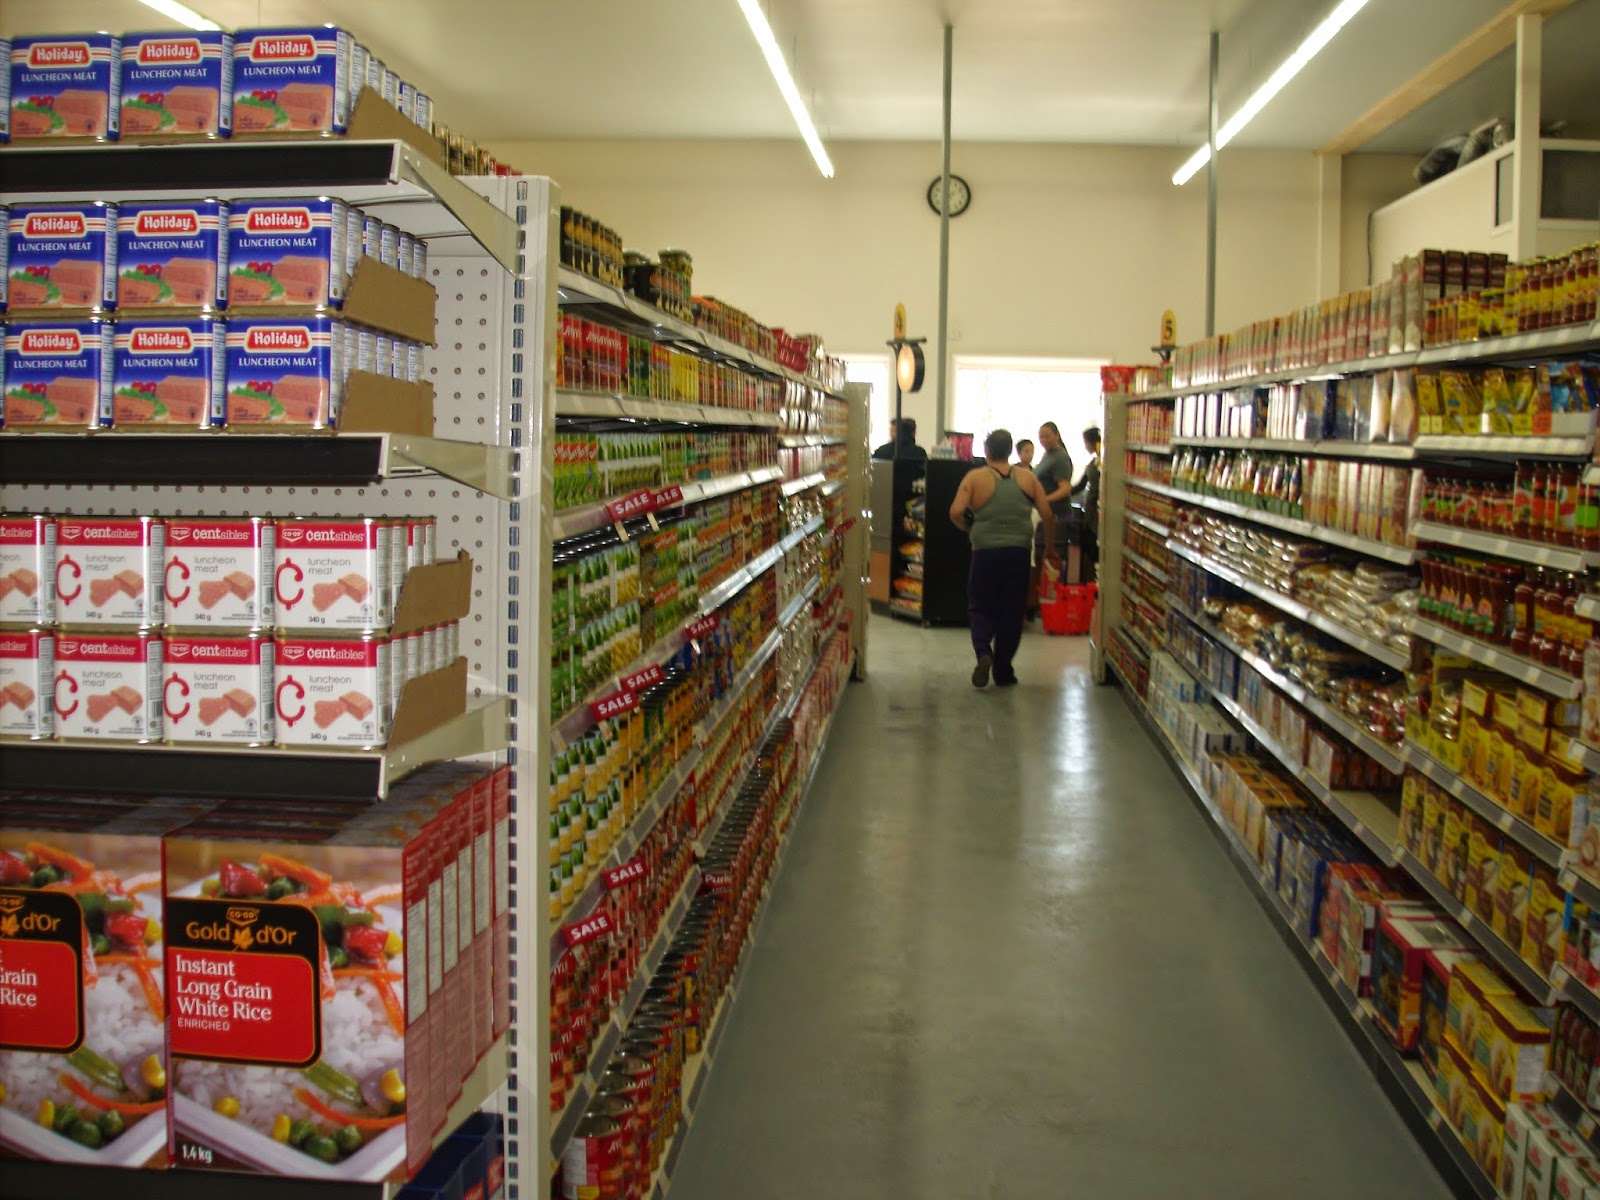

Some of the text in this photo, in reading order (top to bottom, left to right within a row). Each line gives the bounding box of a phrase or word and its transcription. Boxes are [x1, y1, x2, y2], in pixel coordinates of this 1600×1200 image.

[36, 48, 83, 62] Holiday
[146, 44, 194, 59] Holiday
[259, 41, 311, 56] Holiday
[21, 71, 97, 82] LUNCHEON MEAT
[130, 68, 208, 79] LUNCHEON MEAT
[243, 65, 322, 76] LUNCHEON MEAT
[32, 218, 79, 232] Holiday
[143, 215, 192, 230] Holiday
[254, 213, 304, 228] Holiday
[17, 242, 92, 252] LUNCHEON MEAT
[128, 239, 205, 250] LUNCHEON MEAT
[239, 237, 317, 247] LUNCHEON MEAT
[1163, 319, 1173, 340] 5
[27, 334, 75, 349] Holiday
[138, 333, 185, 348] Holiday
[253, 331, 303, 347] Holiday
[14, 359, 88, 369] LUNCHEON MEAT
[123, 358, 199, 368] LUNCHEON MEAT
[238, 357, 317, 366] LUNCHEON MEAT
[656, 488, 679, 504] ALE
[614, 492, 650, 515] SALE
[85, 554, 126, 563] luncheon
[194, 556, 236, 564] luncheon
[308, 558, 351, 566] luncheon
[85, 563, 109, 571] meat
[194, 565, 219, 573] meat
[308, 566, 333, 575] meat
[689, 618, 716, 634] SALE
[82, 670, 123, 679] luncheon
[194, 671, 236, 681] luncheon
[309, 675, 352, 684] luncheon
[627, 668, 659, 688] SALE
[82, 679, 106, 687] meat
[194, 682, 218, 690] meat
[309, 684, 334, 692] meat
[598, 693, 633, 715] SALE
[609, 863, 644, 884] SALE
[22, 912, 61, 932] d'Or
[570, 916, 608, 940] SALE
[186, 922, 297, 945] Gold d'Or
[176, 954, 236, 976] Instant
[0, 967, 37, 986] rain
[177, 976, 272, 1000] Long Grain
[0, 987, 37, 1007] Rice
[177, 997, 272, 1021] White Rice
[177, 1018, 230, 1031] ENRICHED
[182, 1144, 213, 1164] 1.4 kg
